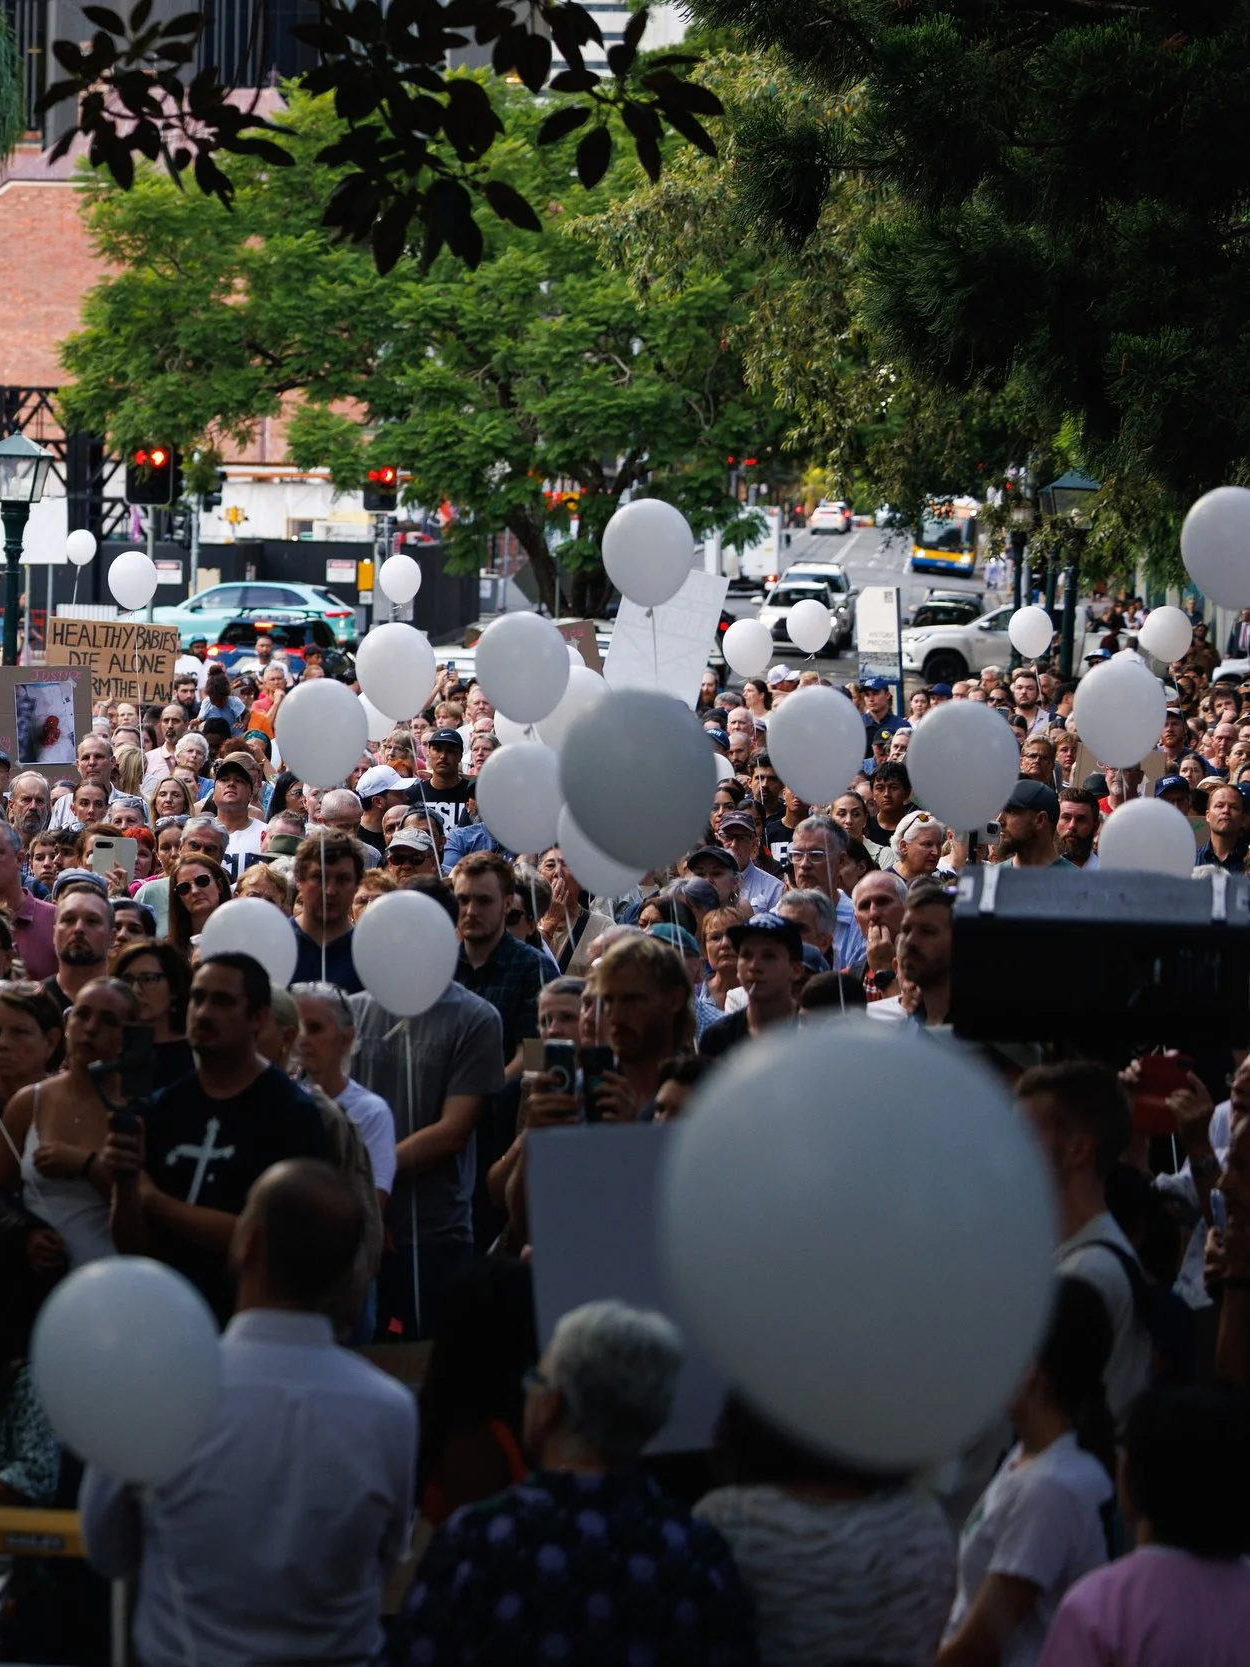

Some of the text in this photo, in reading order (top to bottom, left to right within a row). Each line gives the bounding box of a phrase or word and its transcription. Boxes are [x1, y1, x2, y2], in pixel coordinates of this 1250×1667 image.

[52, 622, 135, 650] HEALTHY
[69, 651, 167, 674] DIE ALONE
[111, 677, 138, 699] THE
